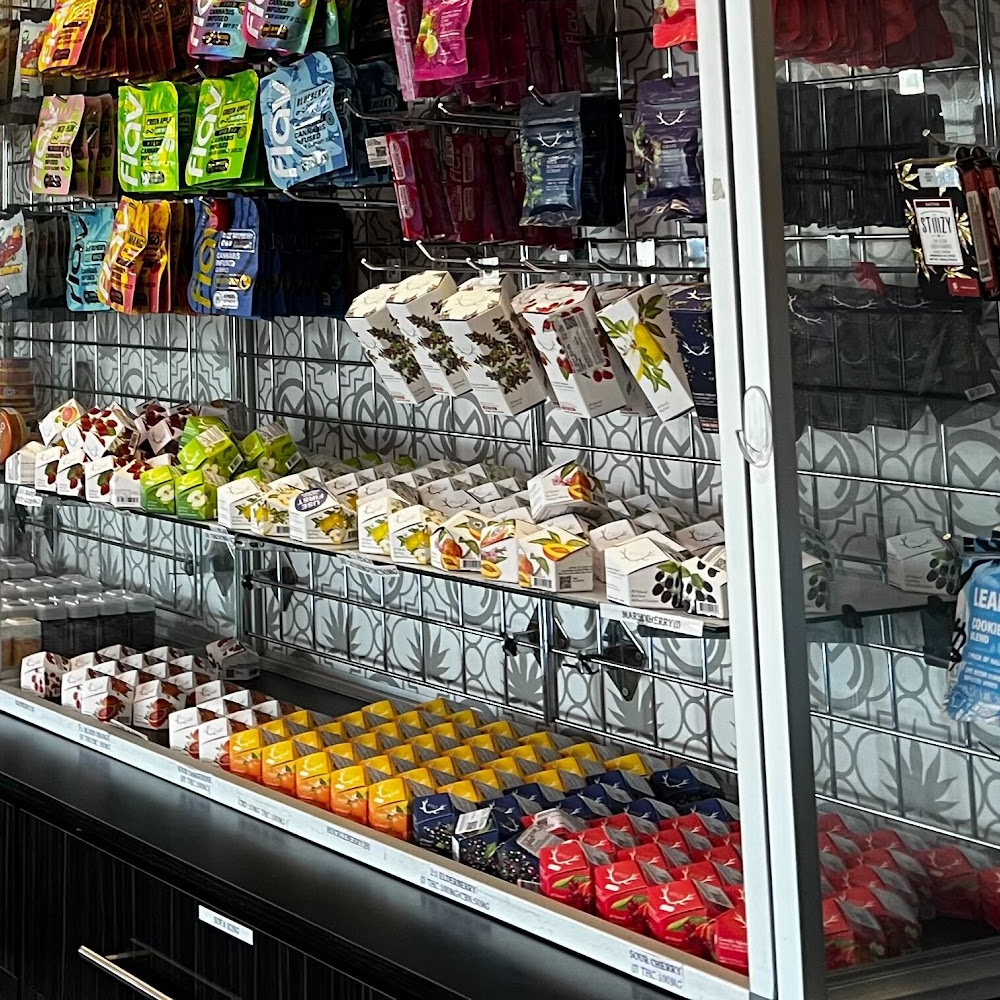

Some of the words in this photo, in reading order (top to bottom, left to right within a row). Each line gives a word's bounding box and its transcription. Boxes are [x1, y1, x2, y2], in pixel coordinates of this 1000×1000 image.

[973, 587, 1000, 612] LEA
[629, 949, 650, 965] SOUR
[649, 958, 682, 976] CHERRY
